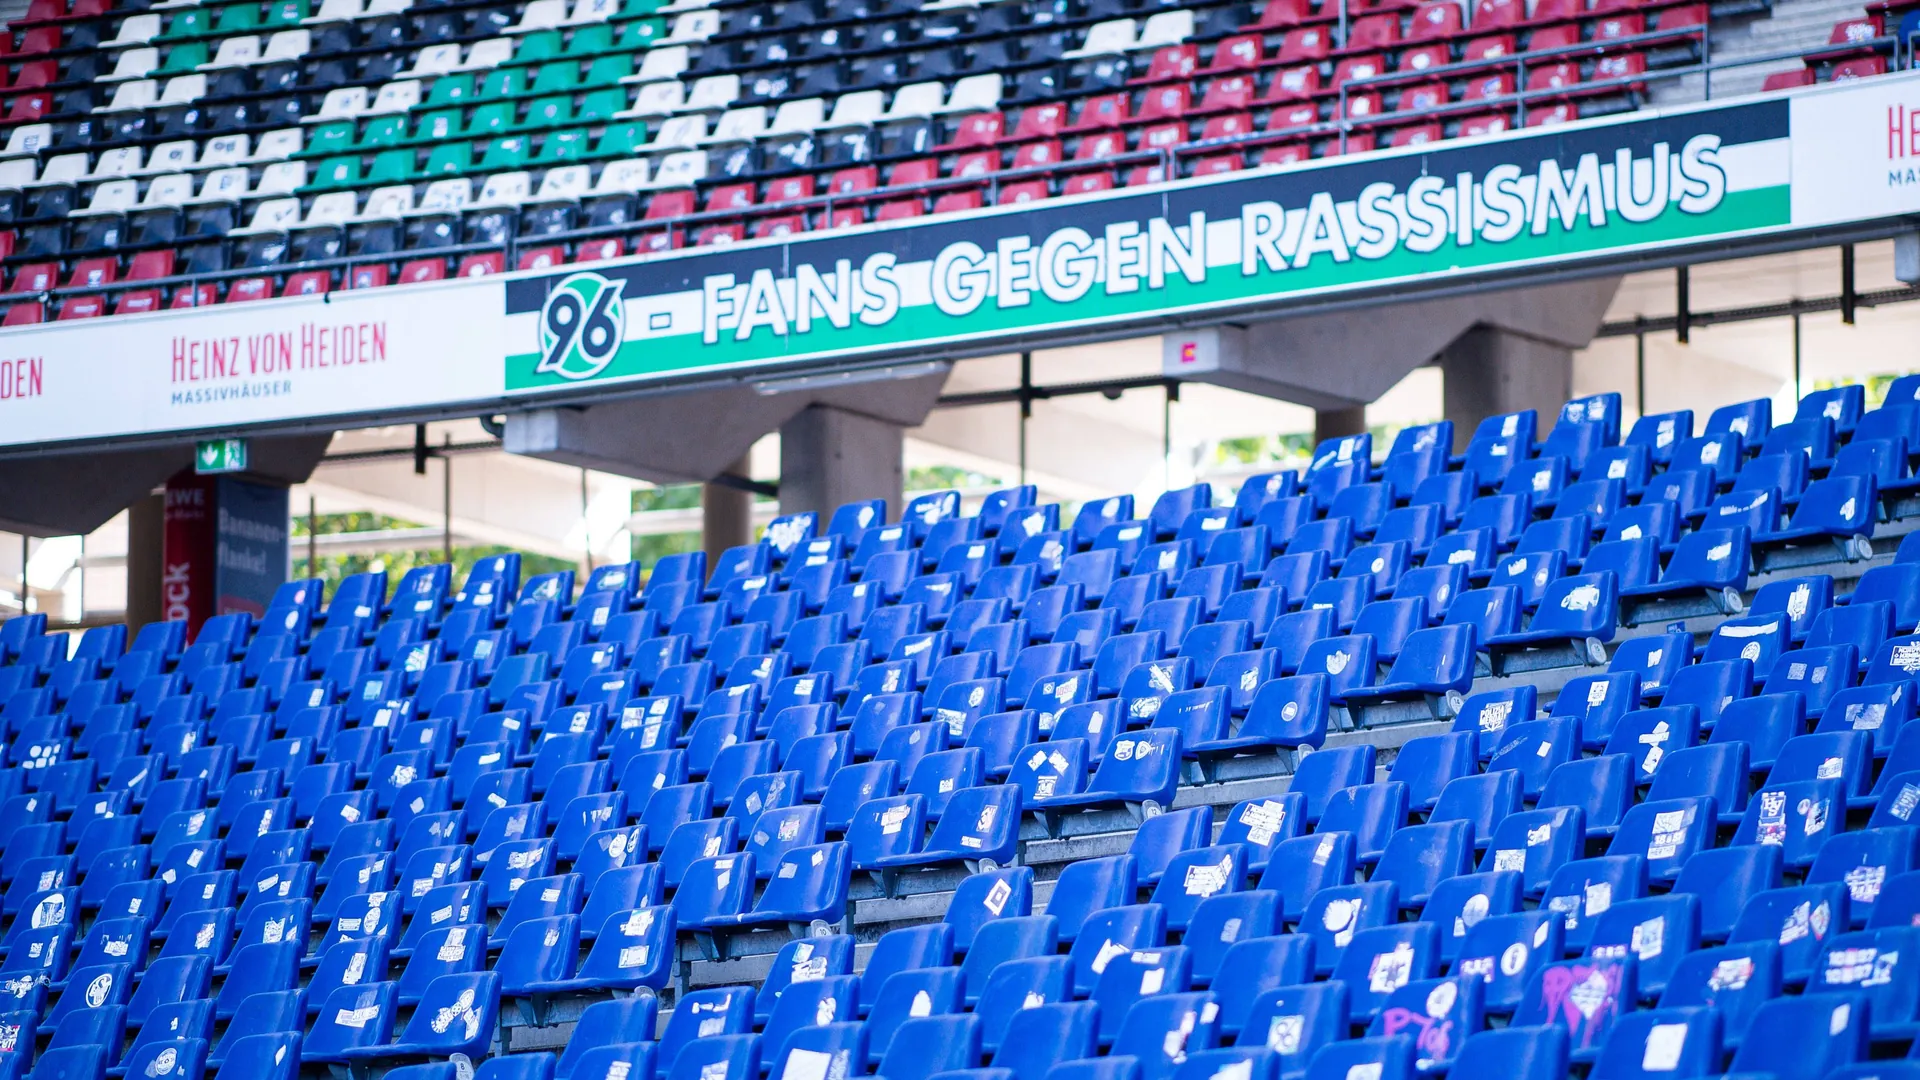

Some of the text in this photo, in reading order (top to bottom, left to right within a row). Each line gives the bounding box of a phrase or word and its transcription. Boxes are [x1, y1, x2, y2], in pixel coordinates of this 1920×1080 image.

[1888, 167, 1920, 187] MA
[539, 279, 622, 371] 96
[702, 252, 901, 345] FANS
[930, 211, 1207, 317] GEGEN
[1240, 133, 1727, 277] RASSISMUS
[172, 322, 386, 382] HEINZ VON HEIDEN
[0, 357, 43, 400] DEN
[171, 379, 292, 405] MASSIVHÄUSER
